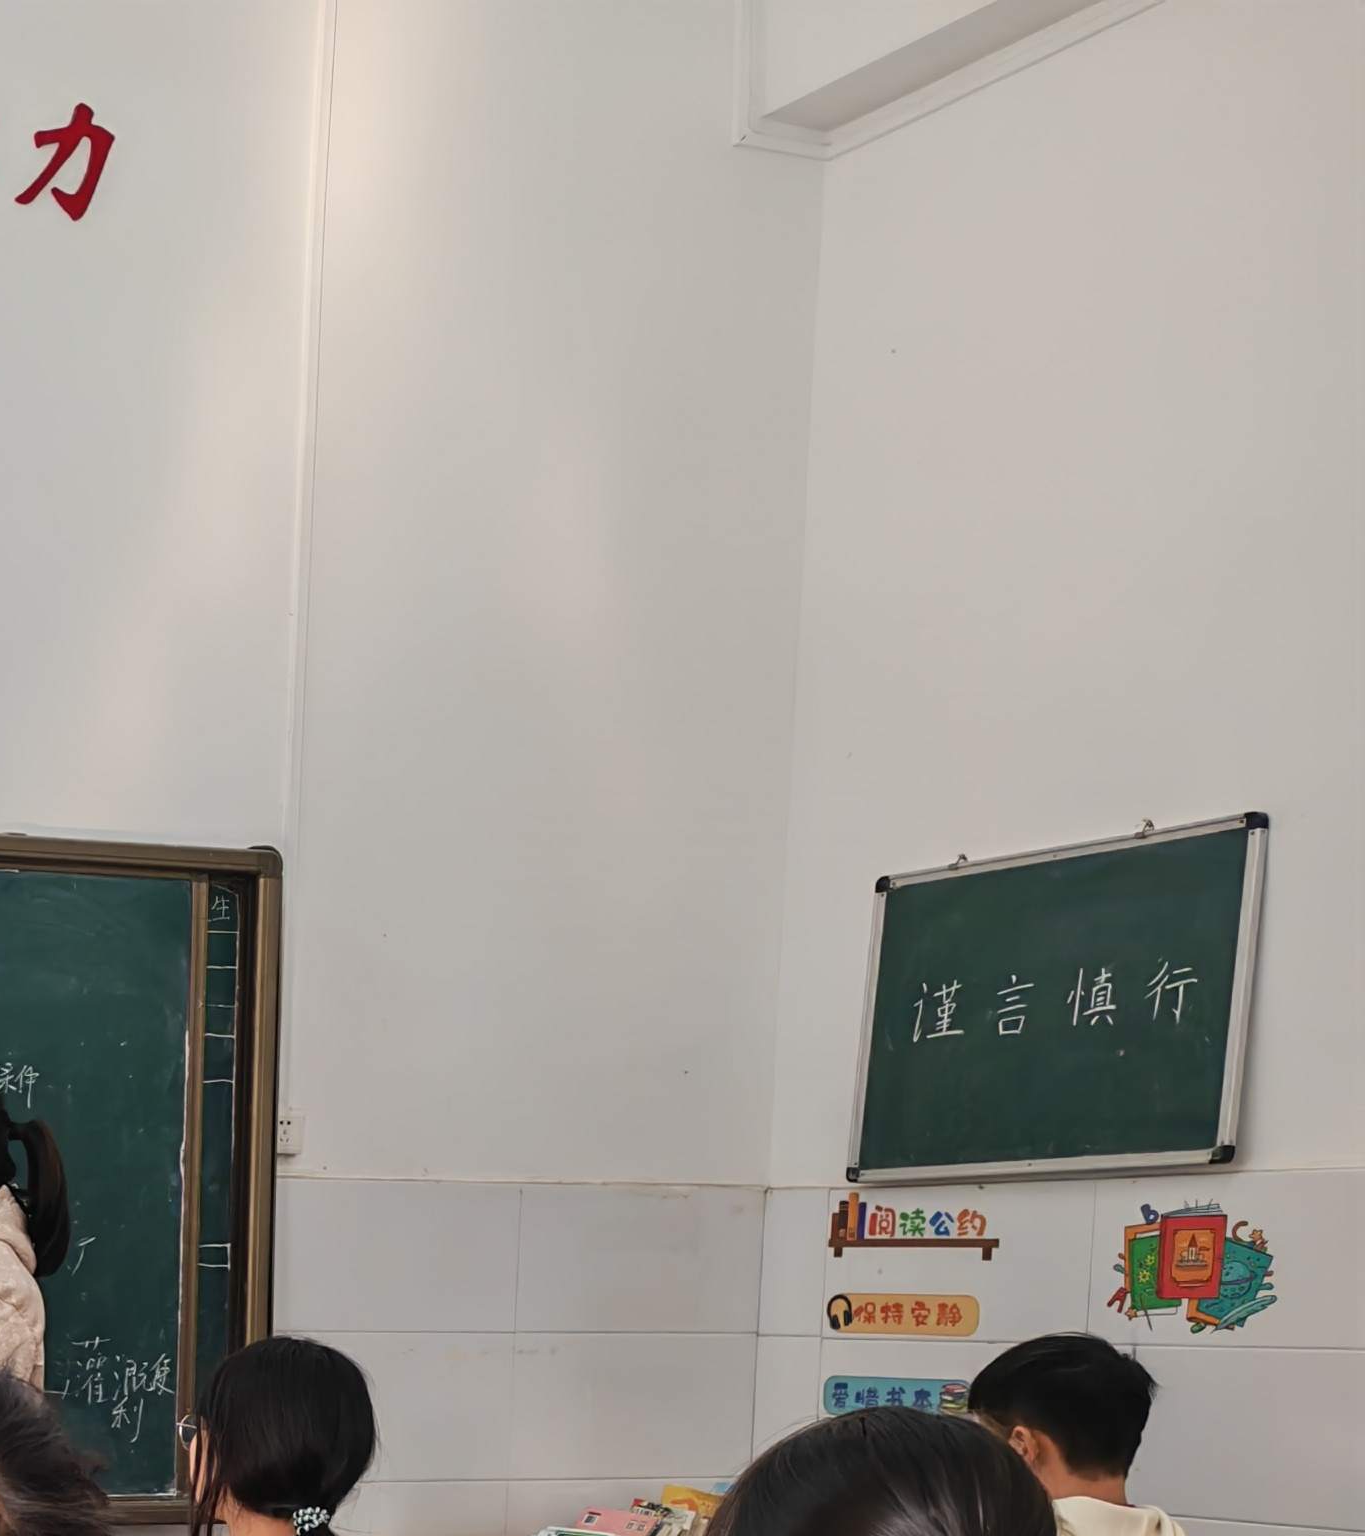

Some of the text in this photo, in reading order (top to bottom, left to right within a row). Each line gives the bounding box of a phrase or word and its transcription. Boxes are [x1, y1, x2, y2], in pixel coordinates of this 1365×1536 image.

[913, 956, 1198, 1042] 谨言慎行
[869, 1205, 987, 1239] 阅读公约
[854, 1300, 962, 1328] 保持安静
[832, 1382, 932, 1409] 爱惜书本
